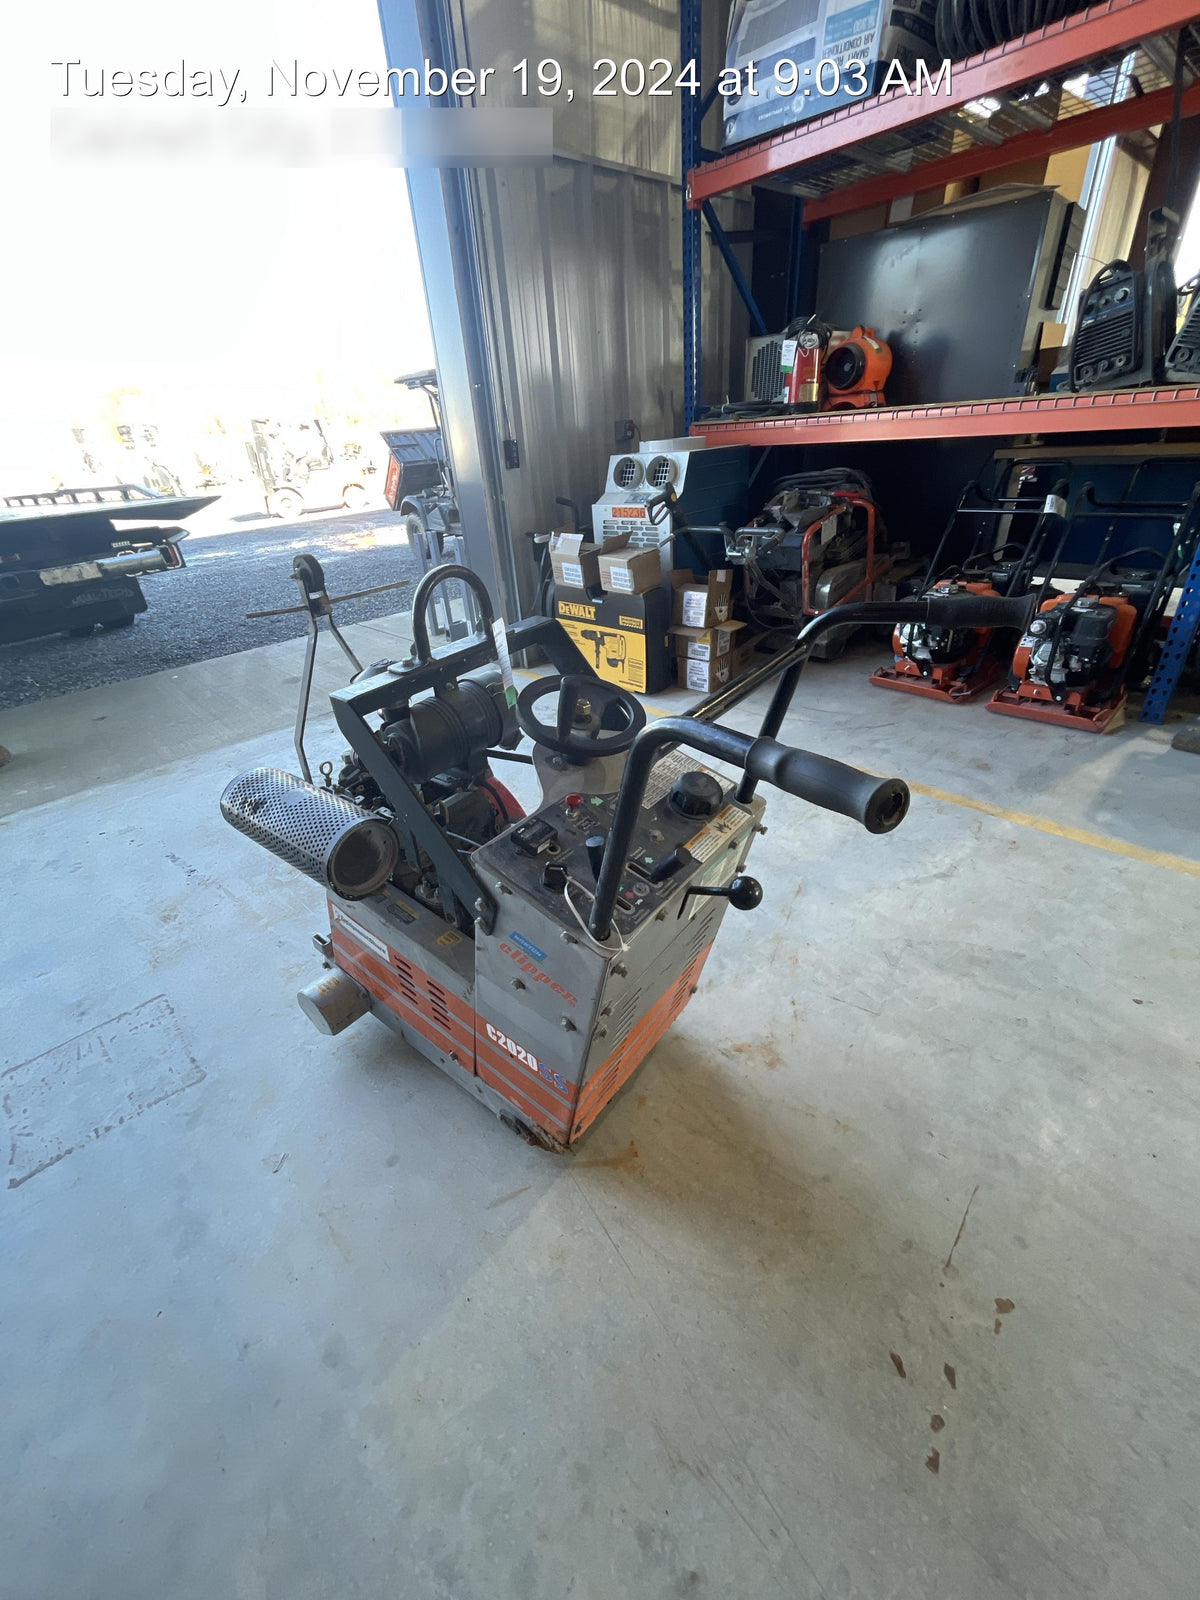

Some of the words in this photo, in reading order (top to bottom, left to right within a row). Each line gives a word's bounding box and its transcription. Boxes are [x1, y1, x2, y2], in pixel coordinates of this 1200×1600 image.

[863, 31, 876, 46] AIR
[822, 36, 862, 58] CONDITIONER
[847, 46, 871, 61] SMART
